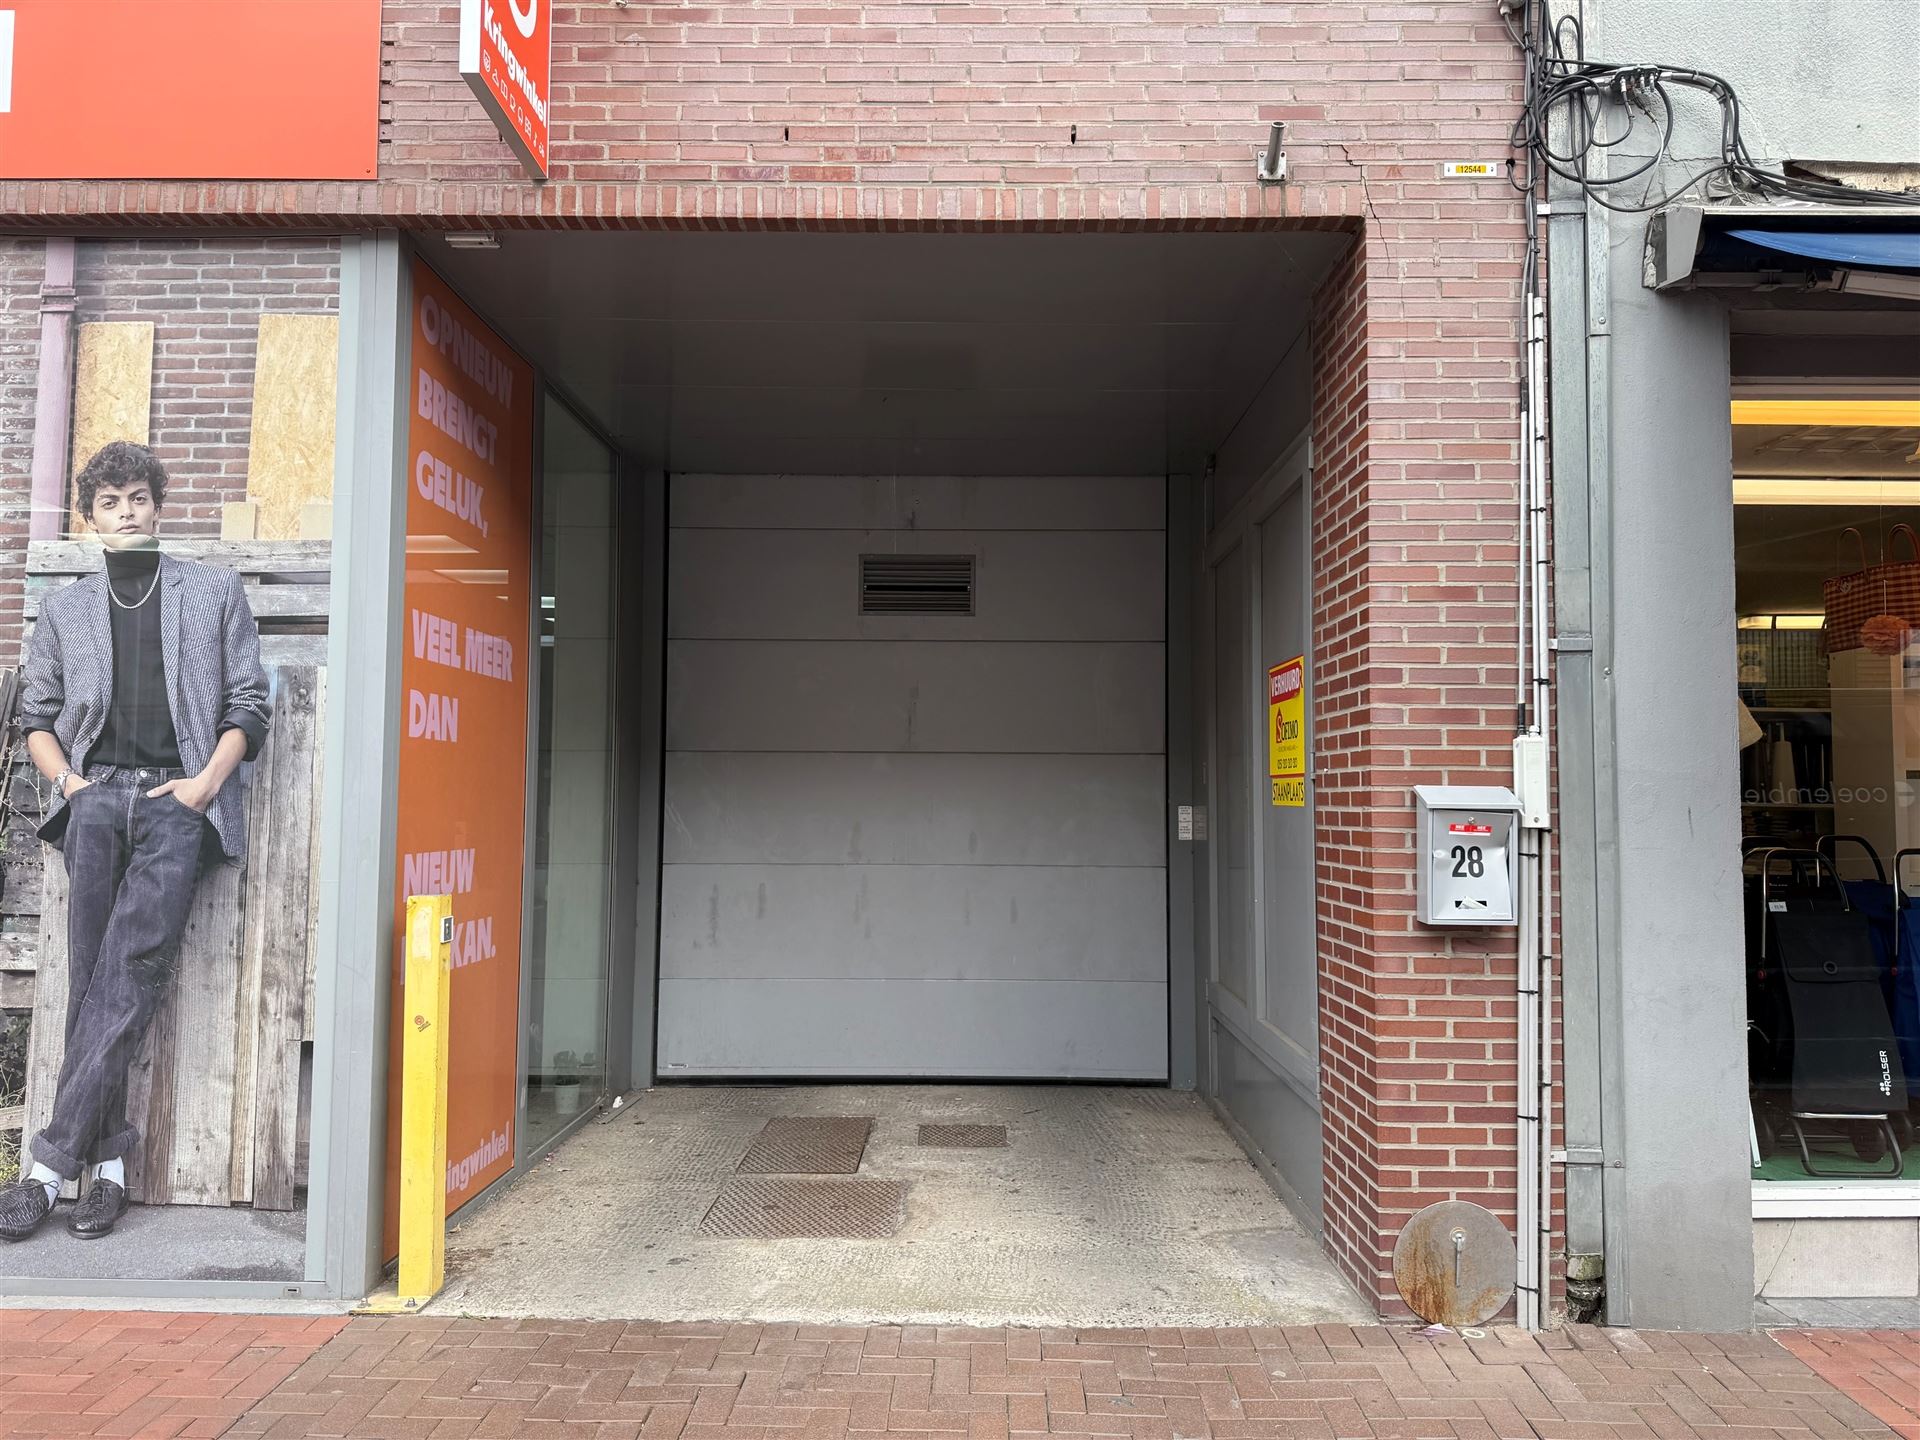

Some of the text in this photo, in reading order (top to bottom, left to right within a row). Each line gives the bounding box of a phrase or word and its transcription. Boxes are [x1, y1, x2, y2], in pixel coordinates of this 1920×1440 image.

[484, 0, 547, 128] Kringwinkel
[1460, 165, 1482, 174] 12544
[420, 294, 513, 411] OPNIEUW
[418, 367, 498, 466] BRENGT
[415, 451, 489, 538] GELUK,
[411, 608, 513, 683] VEEL MEER
[408, 688, 459, 744] DAN
[1272, 782, 1305, 802] STAANPLAATS
[402, 848, 476, 903] NIEUW
[1450, 845, 1485, 879] 28
[1879, 1050, 1892, 1088] ROLSER
[446, 1120, 510, 1195] ingwinkel
